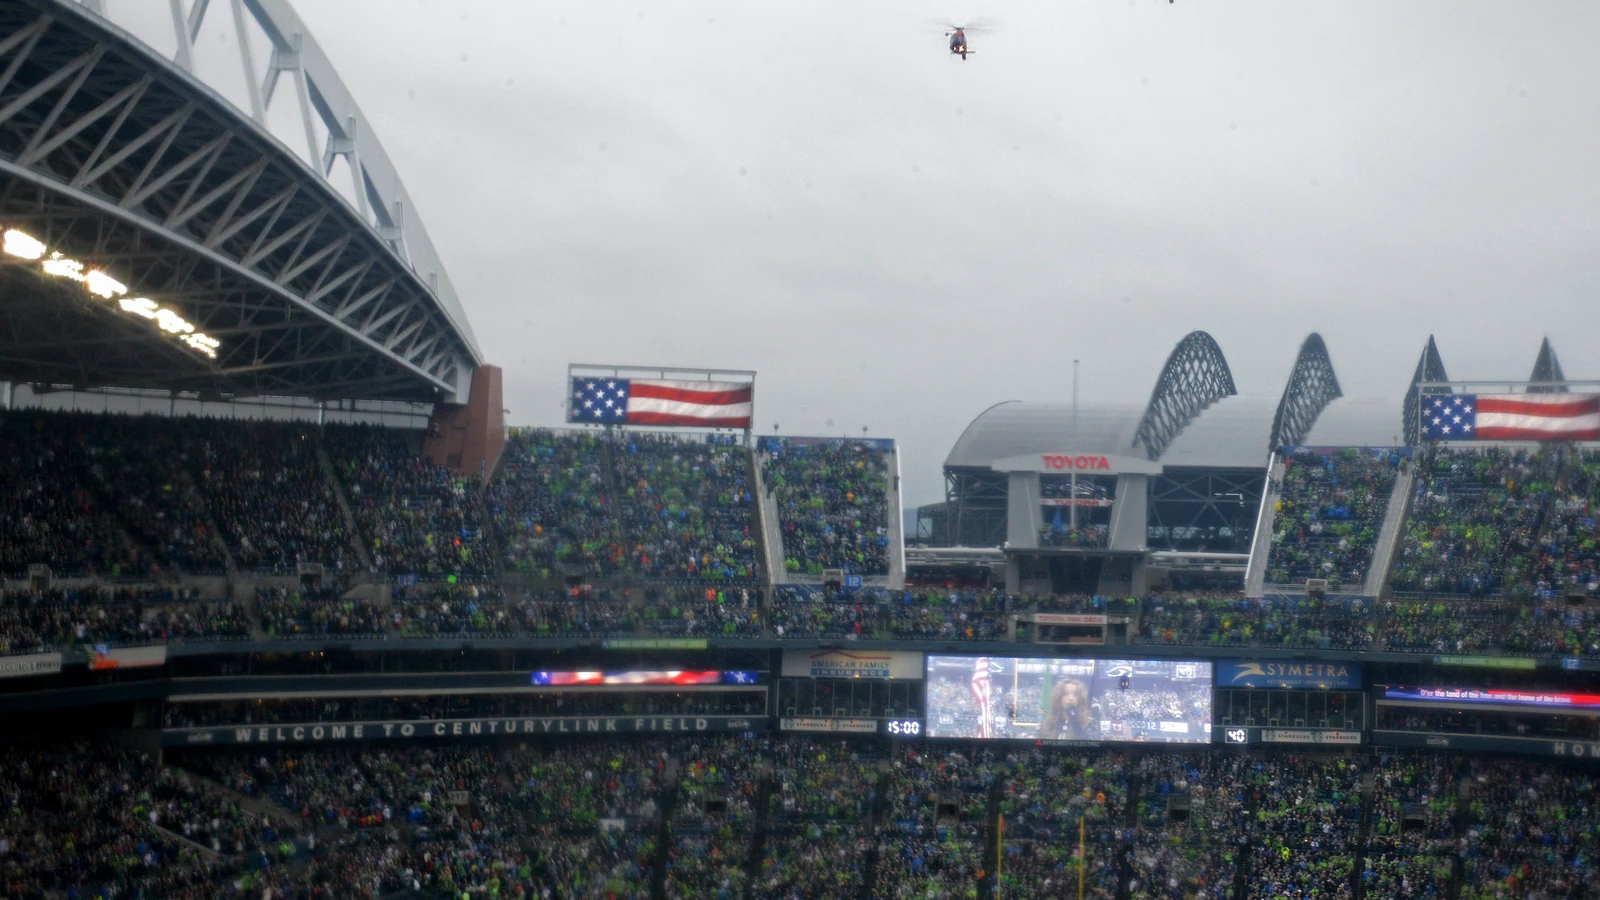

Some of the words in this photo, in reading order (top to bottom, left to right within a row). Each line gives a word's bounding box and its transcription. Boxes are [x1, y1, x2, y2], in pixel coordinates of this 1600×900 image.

[1042, 455, 1111, 470] TOYOTA
[1055, 499, 1100, 507] TUDRA
[848, 577, 859, 586] 12
[812, 660, 856, 668] AMERICAN
[859, 661, 890, 669] FAMILY
[1267, 663, 1348, 677] SYMETRA
[1518, 694, 1535, 702] home
[235, 725, 364, 742] WELCOME
[383, 723, 415, 736] TO
[434, 719, 617, 736] CENTURYLINK
[635, 718, 708, 731] FIELD
[888, 720, 919, 735] 15:00
